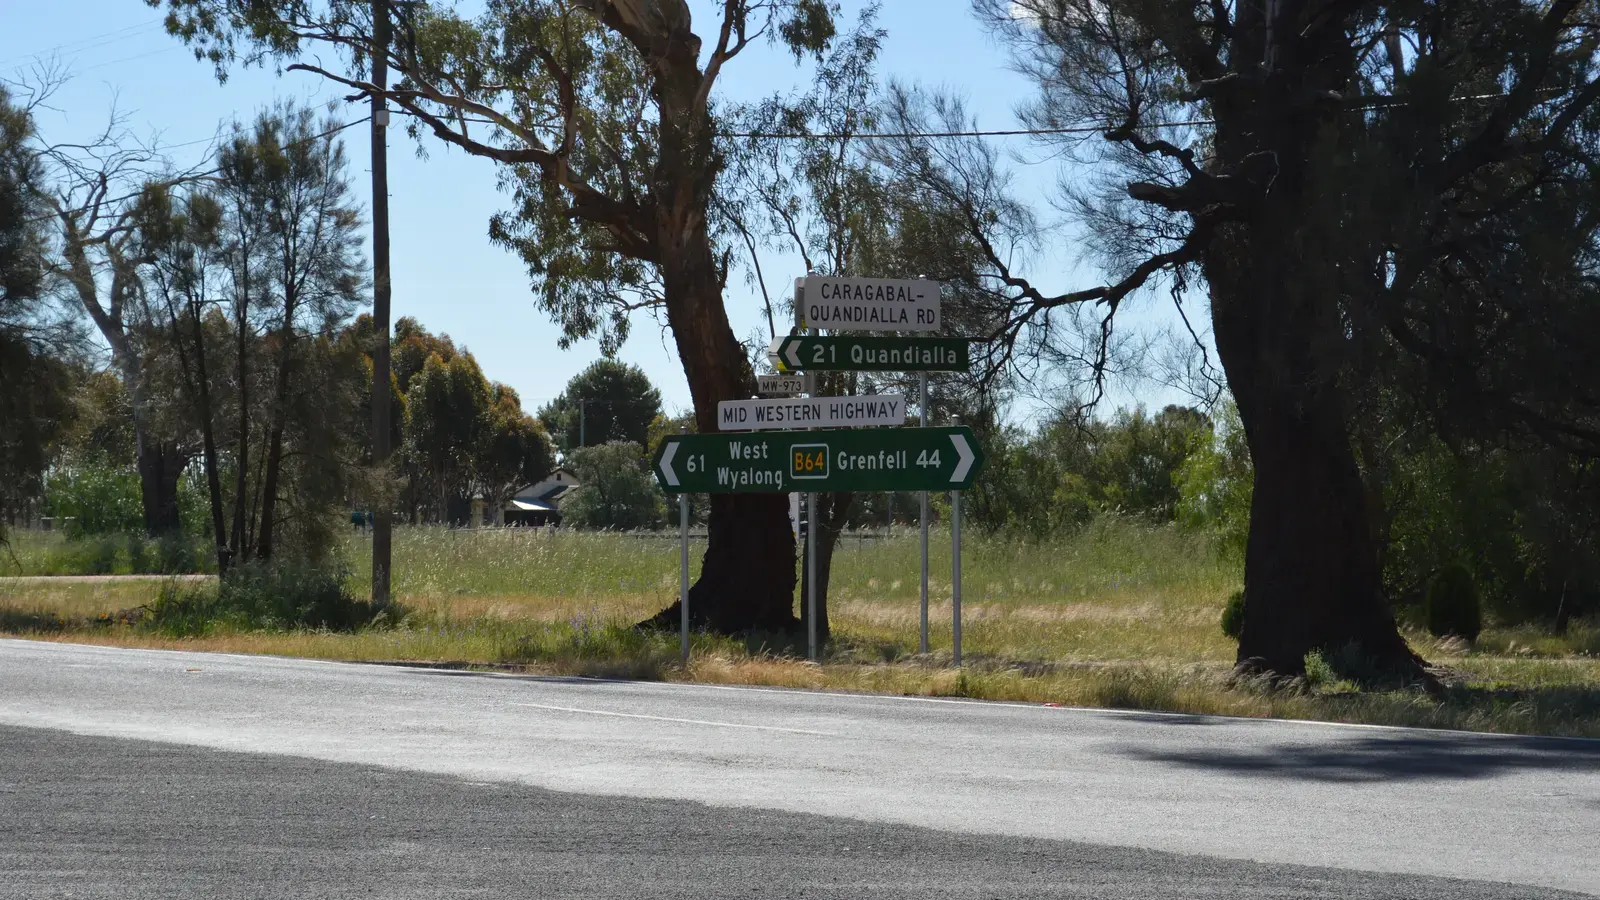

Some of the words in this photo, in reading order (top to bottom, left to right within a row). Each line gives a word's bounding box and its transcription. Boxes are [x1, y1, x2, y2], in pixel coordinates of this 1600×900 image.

[820, 282, 925, 302] CARAGABAL-
[810, 304, 908, 323] QUANDIALLA
[916, 308, 935, 324] RD
[812, 345, 836, 364] 21
[850, 345, 957, 365] Quandialla
[762, 380, 802, 392] MW-973
[723, 408, 747, 424] MID
[755, 404, 821, 421] WESTERN
[829, 401, 898, 418] HIGHWAY
[729, 441, 768, 460] West
[837, 450, 906, 470] Grenfell
[915, 449, 941, 468] 44
[686, 455, 706, 473] 61
[794, 452, 825, 471] B64
[717, 466, 783, 489] Wyalong
